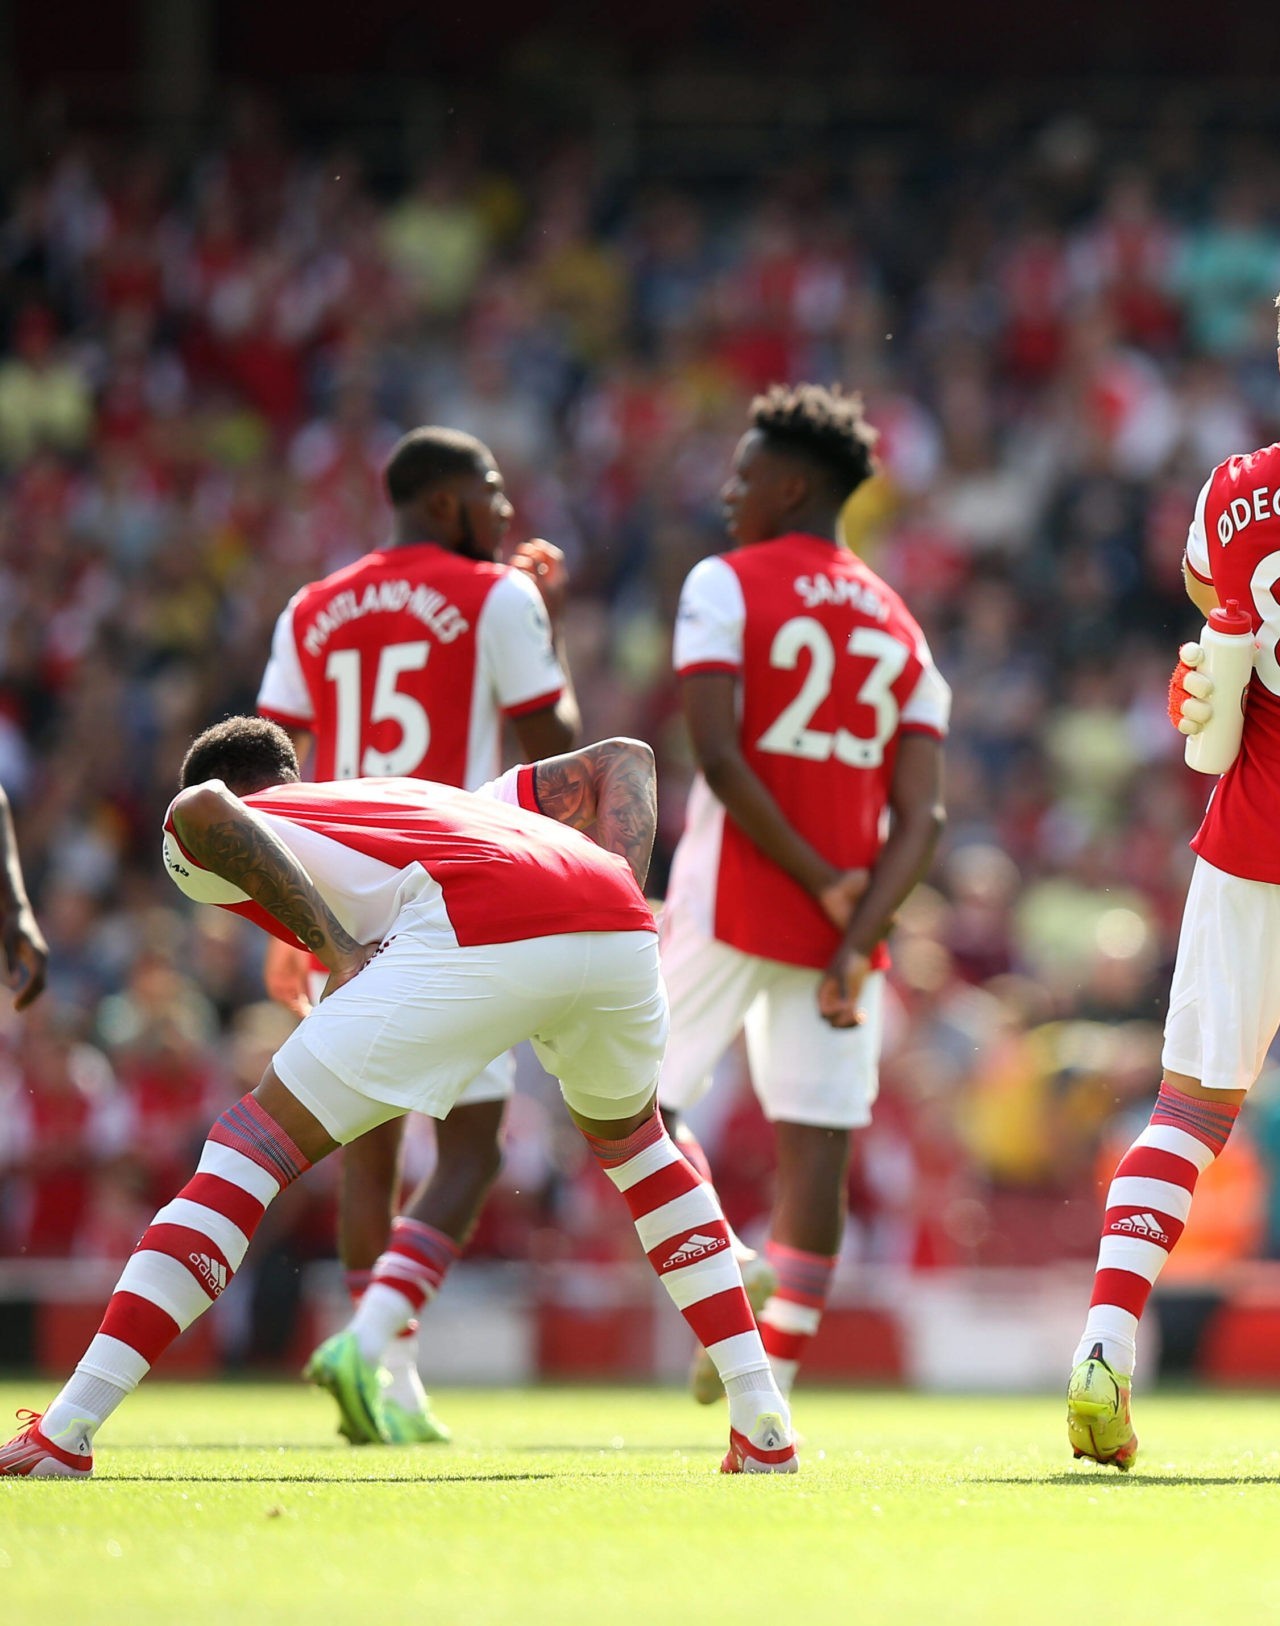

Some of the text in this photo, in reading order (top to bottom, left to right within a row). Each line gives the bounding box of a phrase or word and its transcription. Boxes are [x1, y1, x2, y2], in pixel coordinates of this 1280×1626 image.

[303, 579, 470, 657] MAITLAND-NILES
[325, 640, 431, 781] 15
[756, 616, 911, 769] 23
[662, 1238, 726, 1268] adidas
[1110, 1222, 1169, 1243] adidas
[189, 1252, 223, 1296] adida
